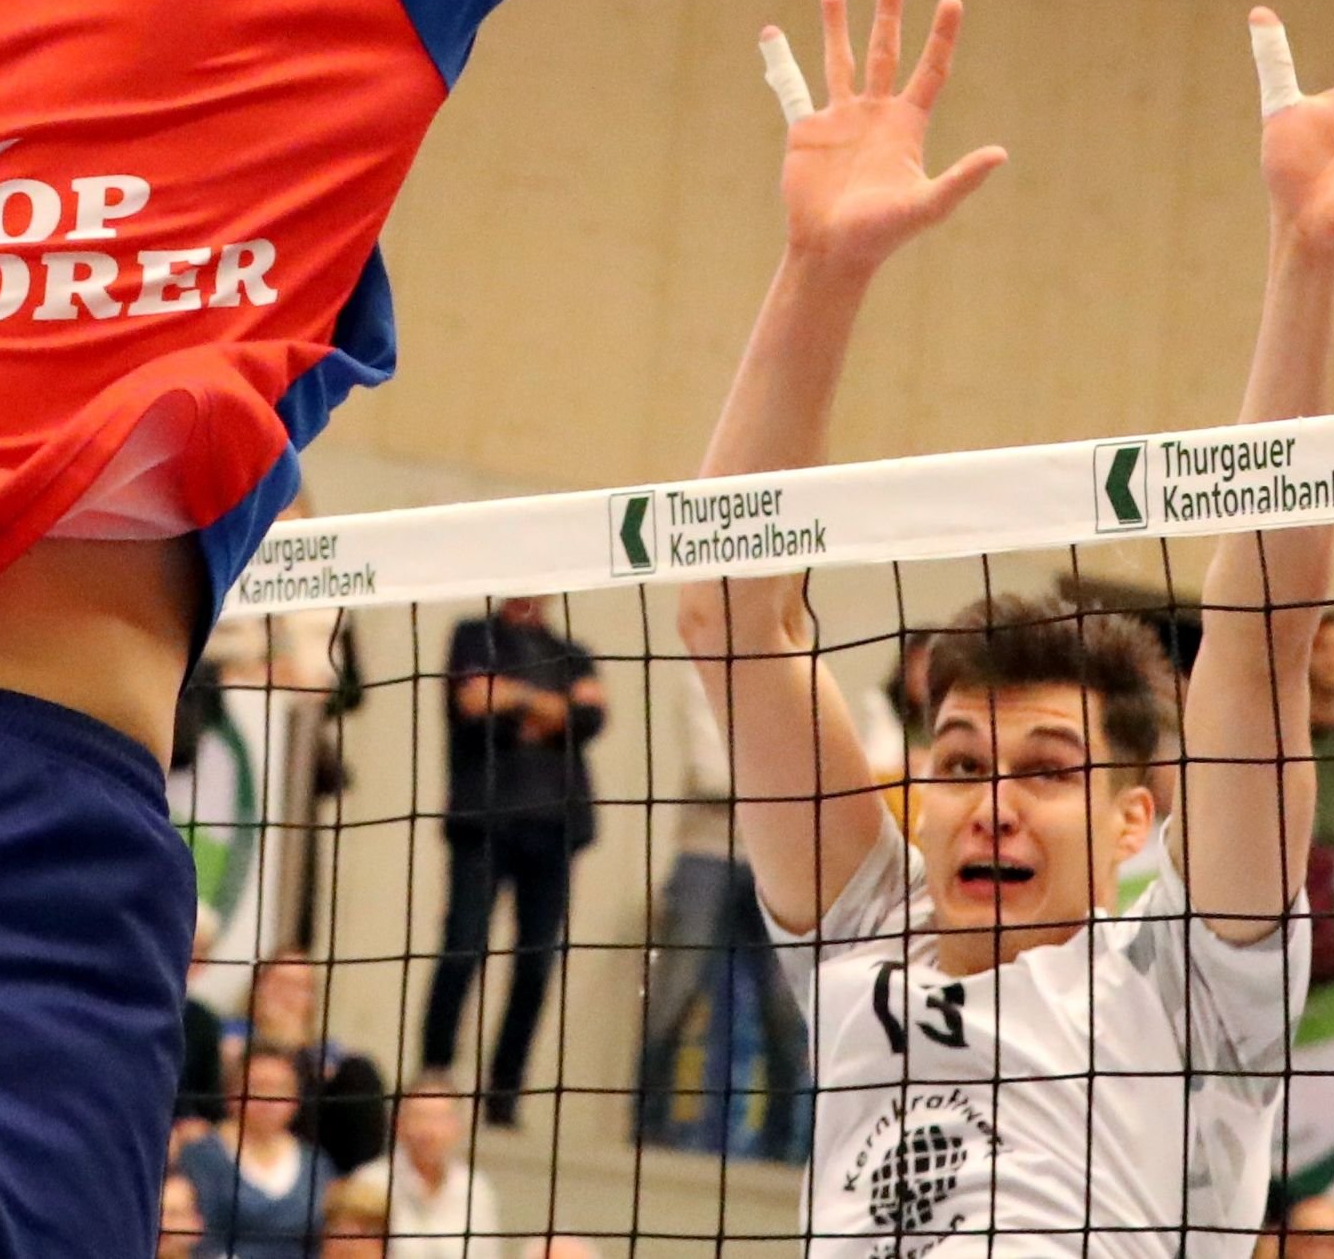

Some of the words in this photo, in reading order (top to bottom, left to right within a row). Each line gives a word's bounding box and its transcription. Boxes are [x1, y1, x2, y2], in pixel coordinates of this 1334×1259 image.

[1160, 437, 1296, 483] Thurgauer
[665, 489, 783, 530] Thurgauer
[250, 534, 339, 572] urgauer
[670, 518, 827, 568] Kantonalbank
[238, 562, 377, 605] Kantonalbank
